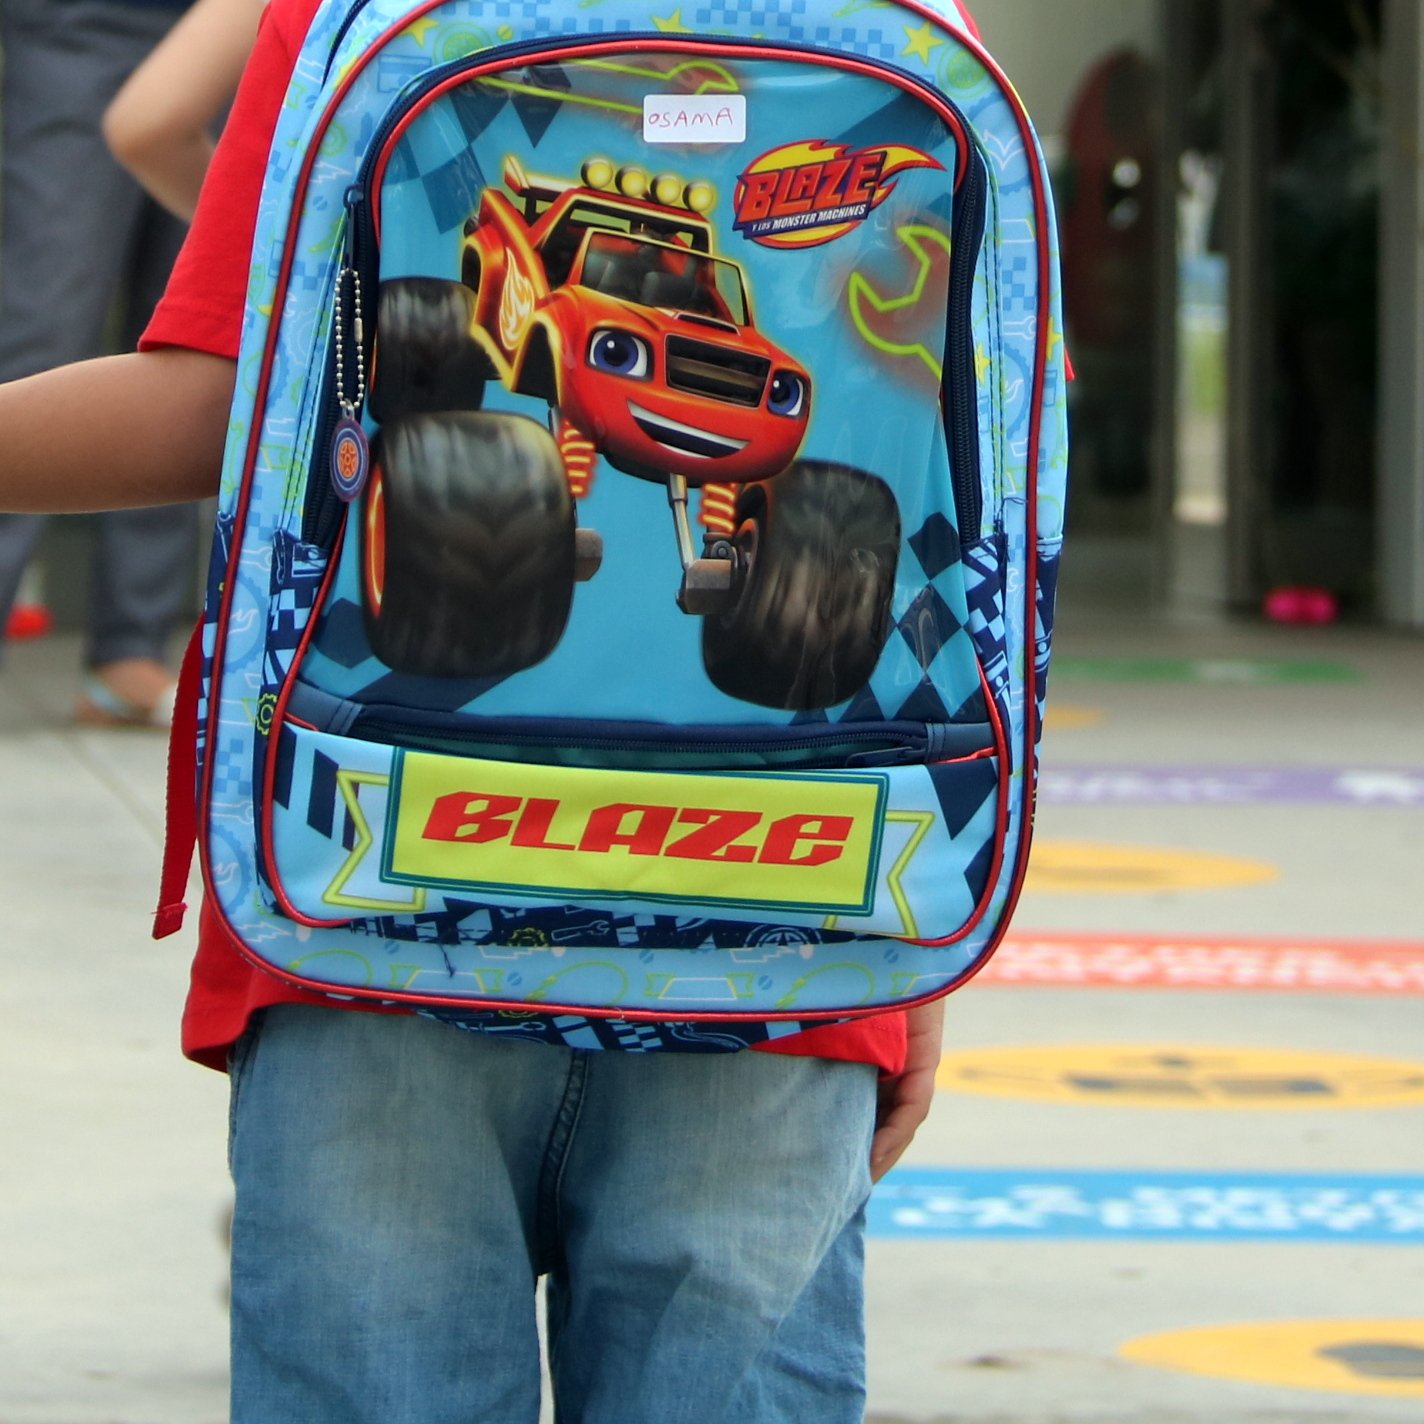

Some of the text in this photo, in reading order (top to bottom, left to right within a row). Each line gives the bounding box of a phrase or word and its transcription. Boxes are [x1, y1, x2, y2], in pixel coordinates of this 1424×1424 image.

[648, 106, 733, 128] OSAMA
[736, 151, 884, 223] BLAZE
[751, 203, 867, 233] Y LOS MONSTER MACHINES
[421, 790, 855, 867] BLAZE
